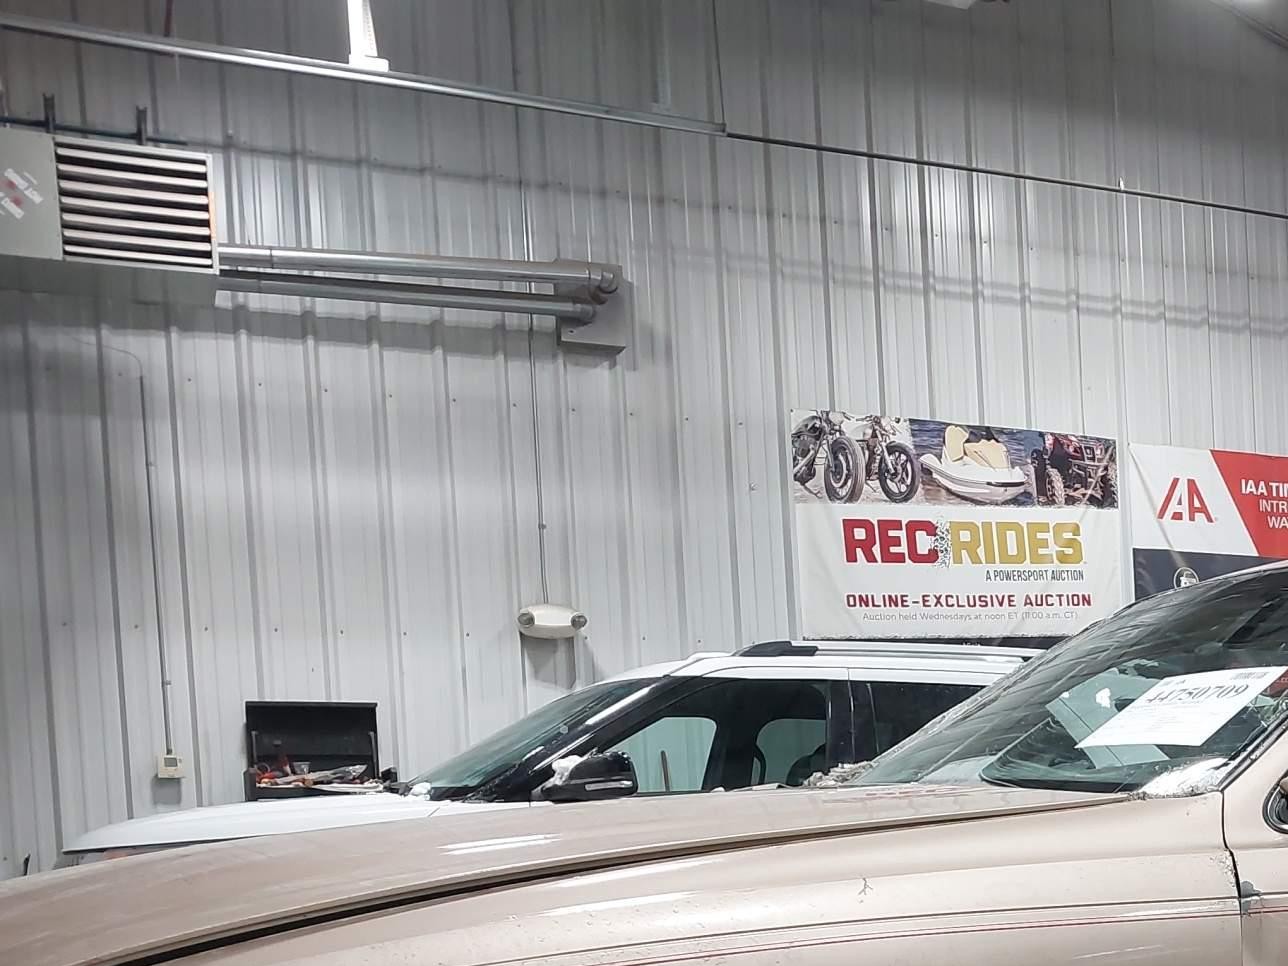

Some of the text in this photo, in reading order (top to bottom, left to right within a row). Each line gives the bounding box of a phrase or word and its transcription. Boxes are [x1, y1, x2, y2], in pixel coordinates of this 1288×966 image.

[1241, 478, 1268, 497] IAA
[985, 569, 1084, 582] A POWERSPORT AUCTION
[846, 593, 1092, 608] ONLINE-EXCLUSIVE AUCTION
[863, 612, 897, 621] Auction
[899, 612, 918, 621] held
[919, 612, 972, 622] Wednesdays
[974, 613, 983, 621] at
[984, 613, 1006, 621] noon
[1146, 684, 1250, 704] 44750709
